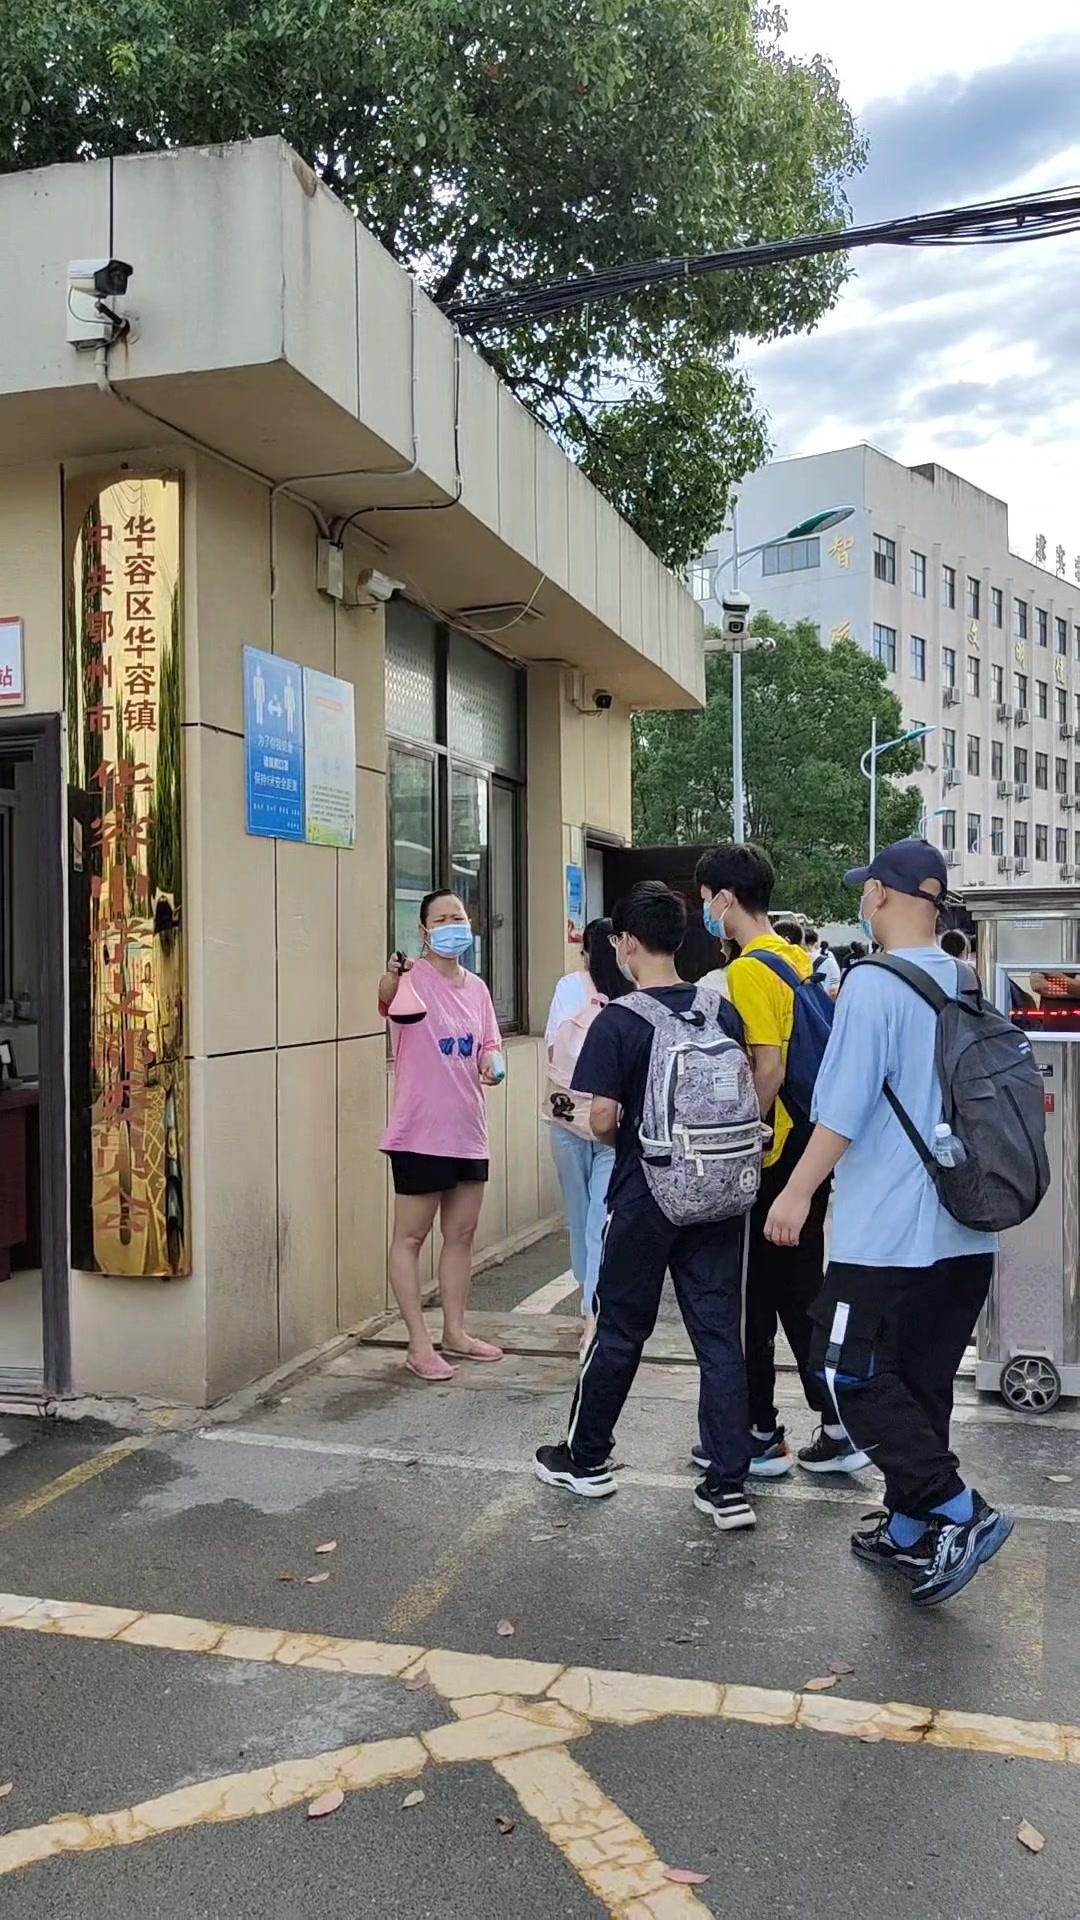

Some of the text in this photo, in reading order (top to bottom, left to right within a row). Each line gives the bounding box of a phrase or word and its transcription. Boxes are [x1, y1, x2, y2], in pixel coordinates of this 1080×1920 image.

[86, 521, 114, 735] 中共鄂州市
[123, 515, 157, 732] 华容区华容镇
[827, 536, 854, 569] 智
